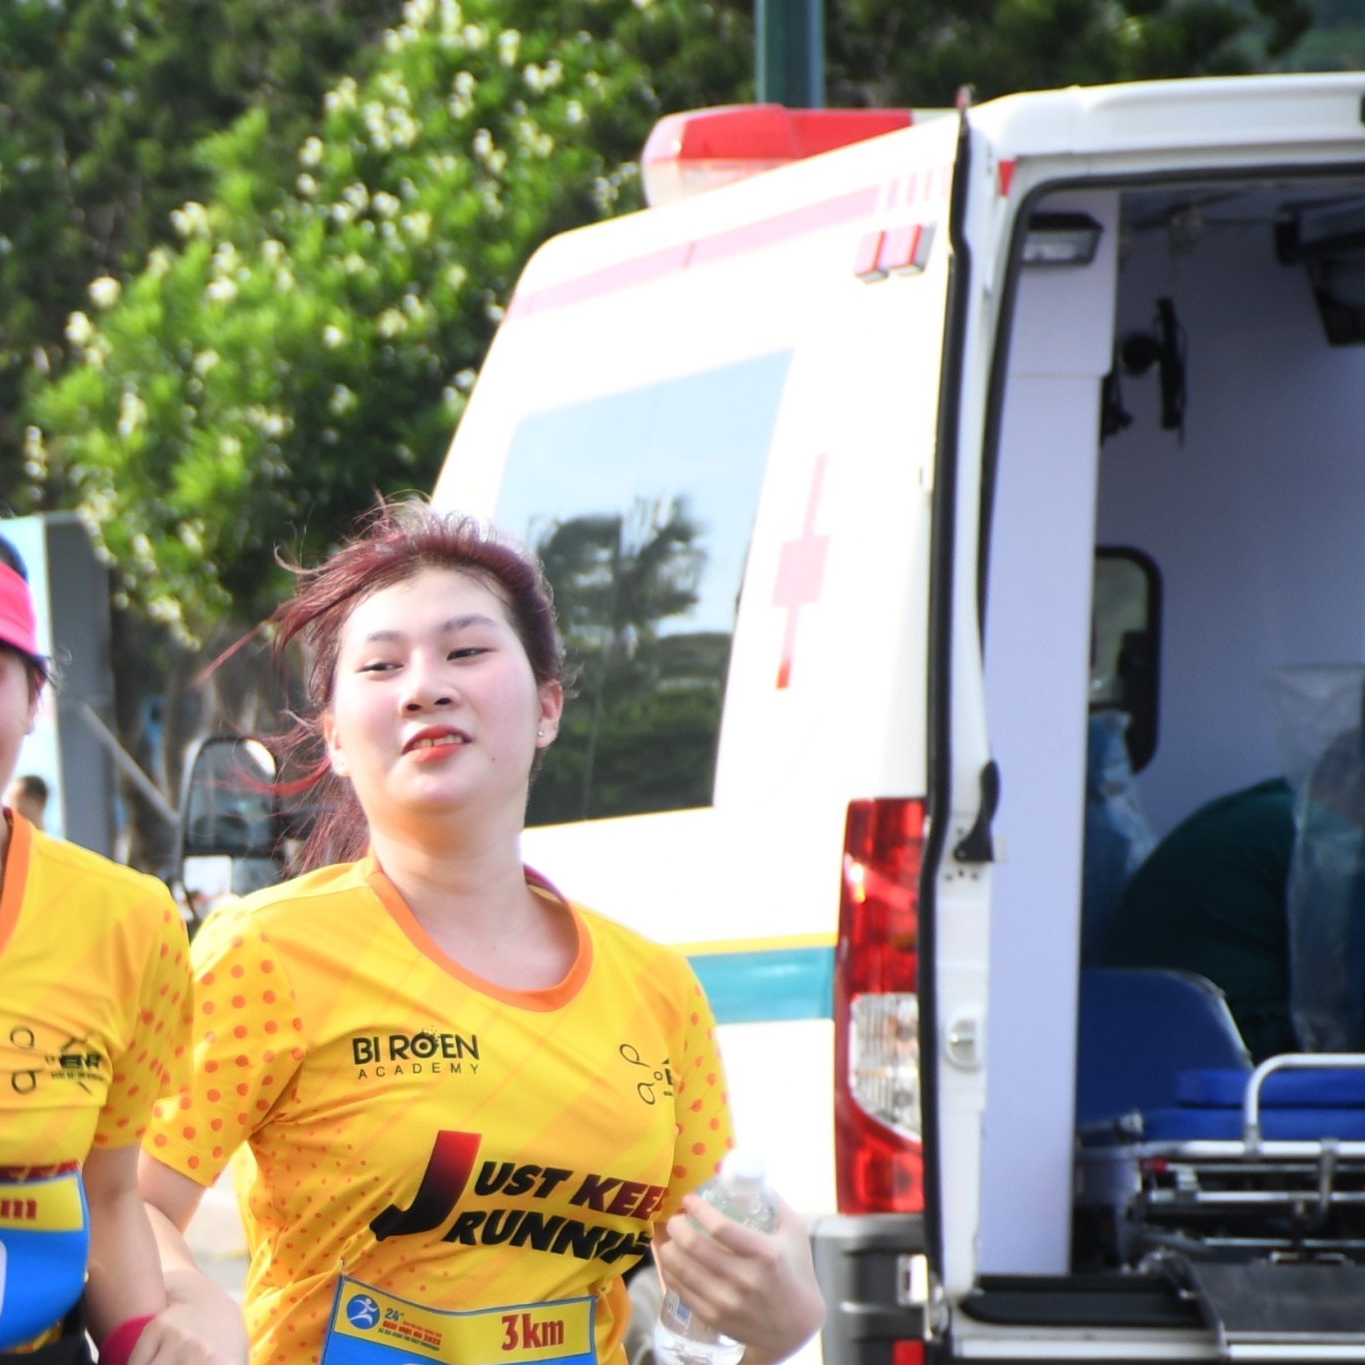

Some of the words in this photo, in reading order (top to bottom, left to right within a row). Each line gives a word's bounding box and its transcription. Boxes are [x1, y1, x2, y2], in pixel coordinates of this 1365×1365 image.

[353, 1036, 381, 1065] BI
[389, 1031, 480, 1061] ROEN
[358, 1061, 479, 1080] ACADEMY
[501, 1303, 565, 1351] 3km
